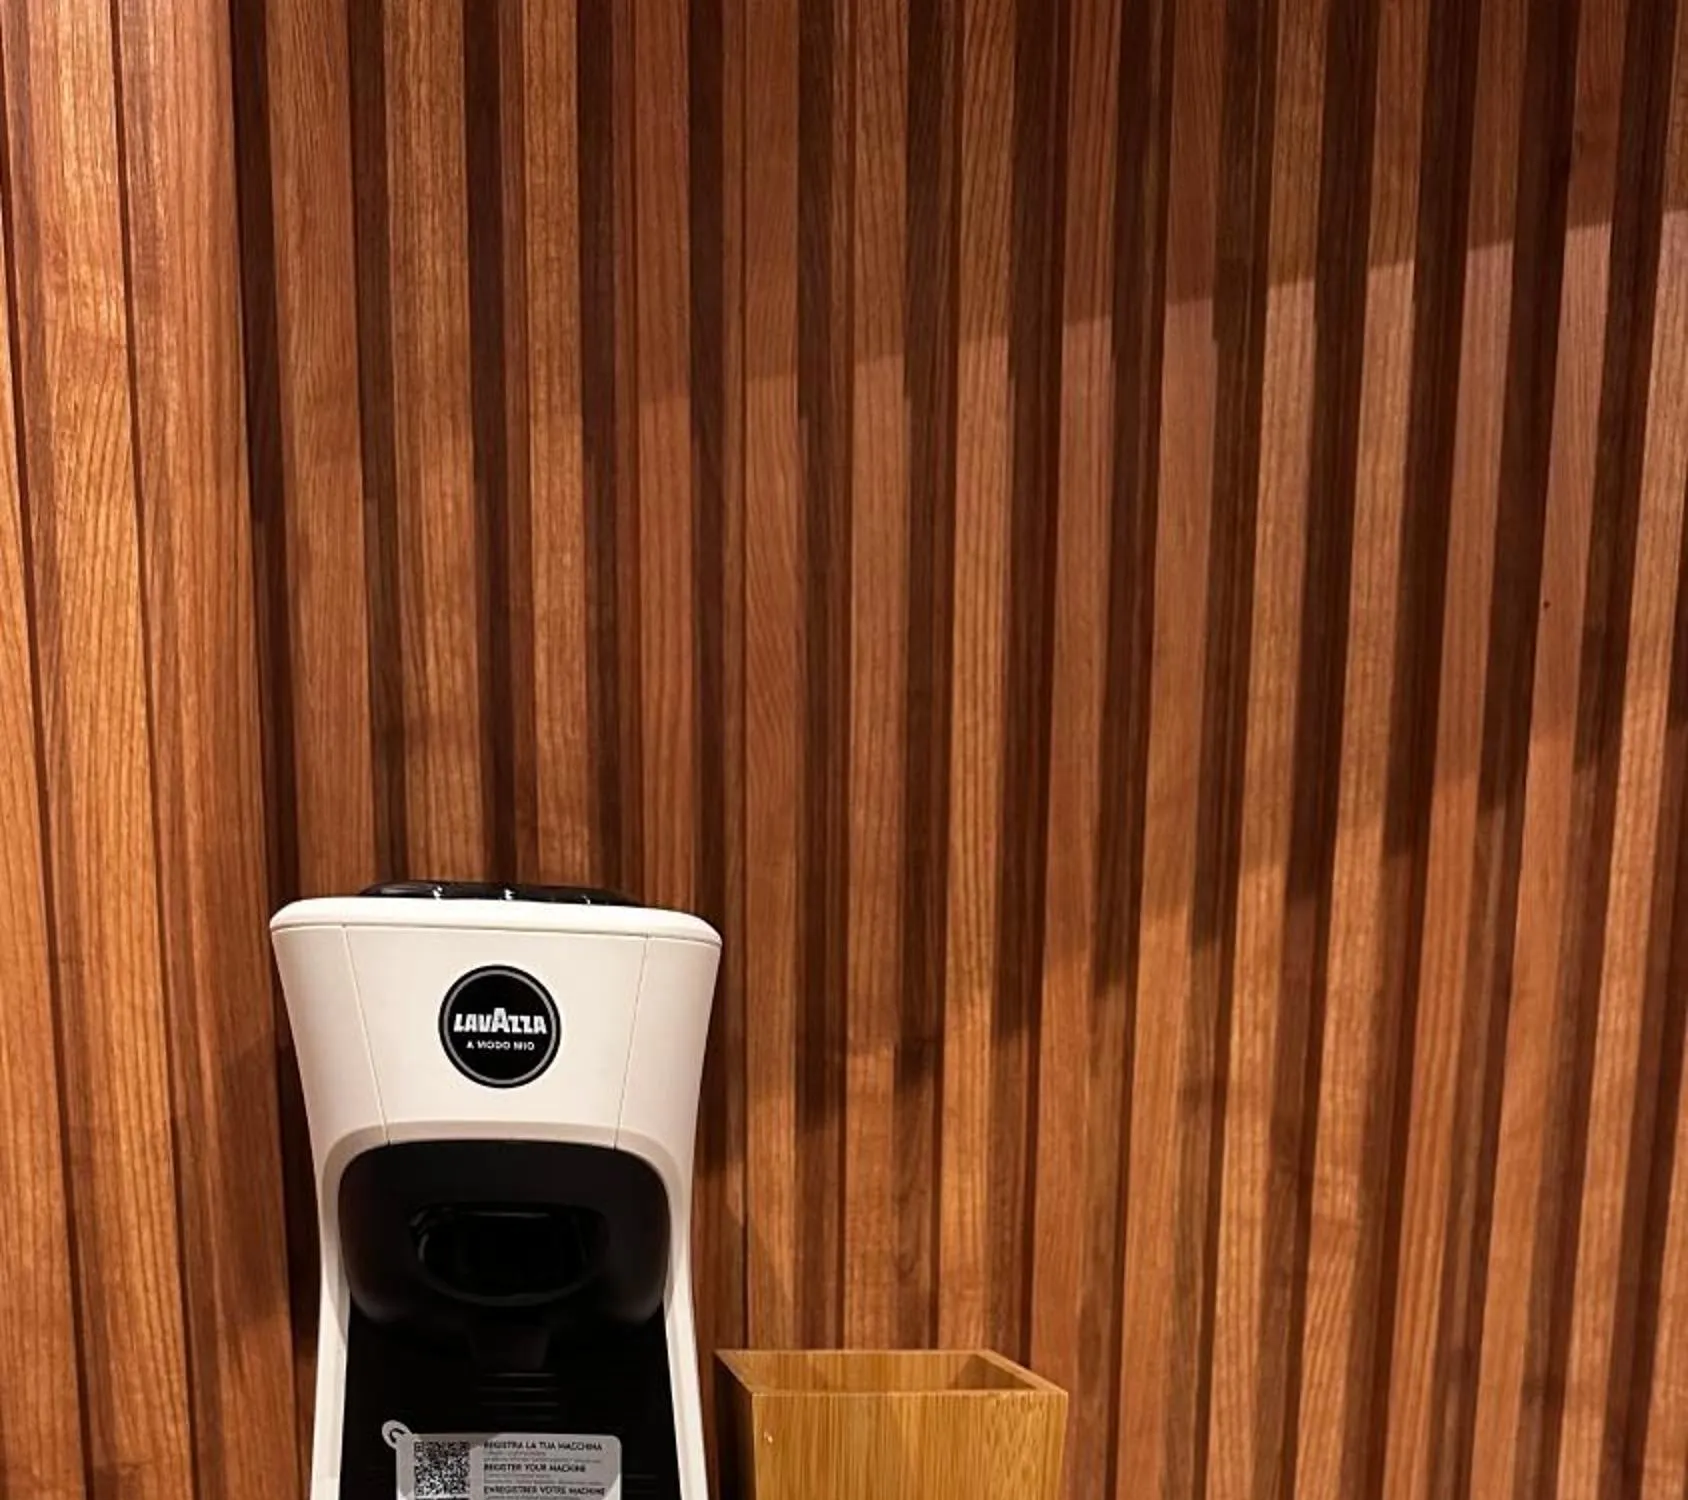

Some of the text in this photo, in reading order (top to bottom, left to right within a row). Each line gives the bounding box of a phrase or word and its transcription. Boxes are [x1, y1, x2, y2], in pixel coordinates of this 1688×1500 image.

[453, 1007, 548, 1034] LAVAZZA
[466, 1040, 535, 1051] A MODO MIO
